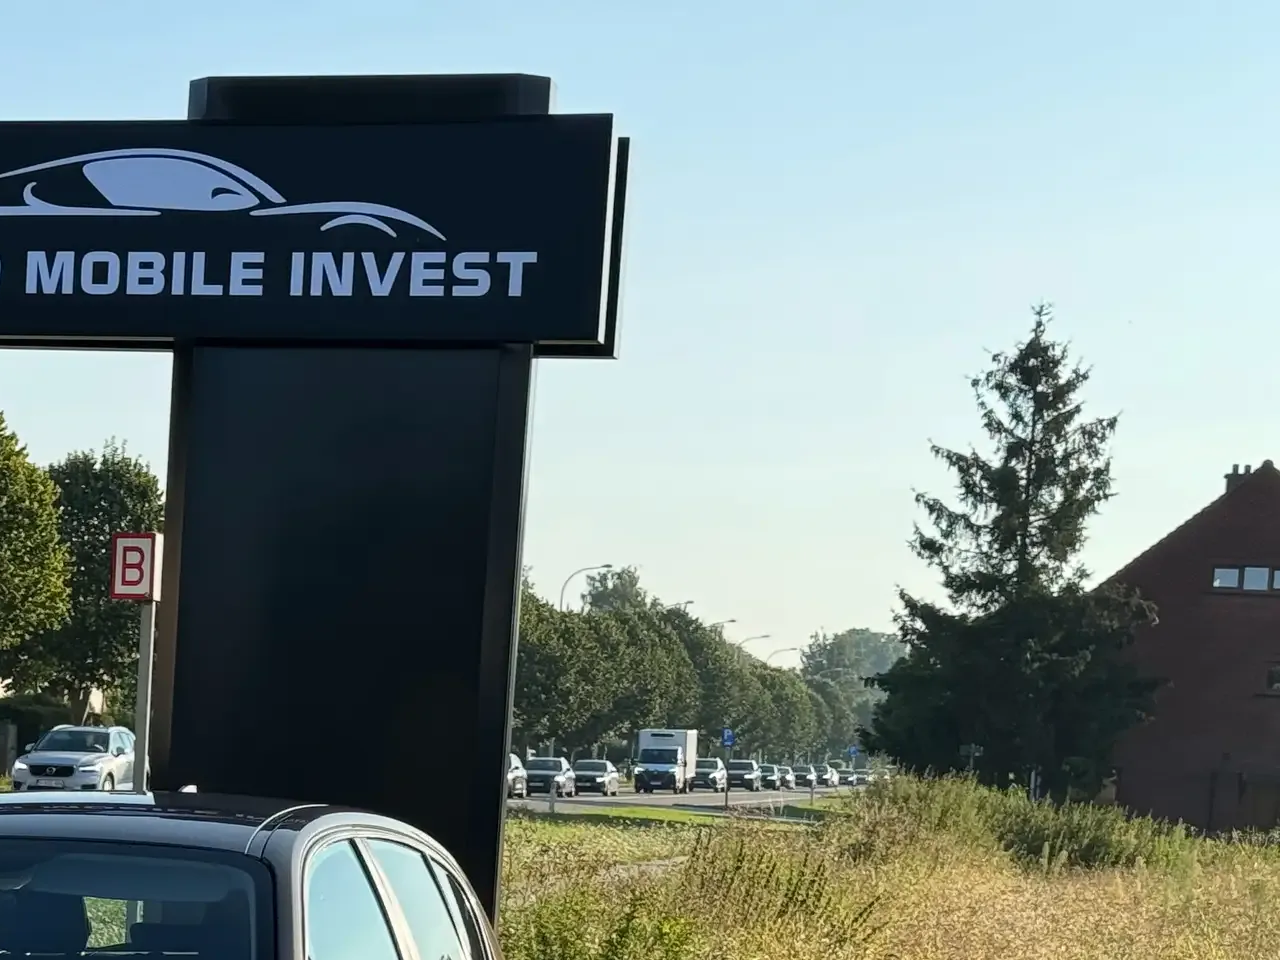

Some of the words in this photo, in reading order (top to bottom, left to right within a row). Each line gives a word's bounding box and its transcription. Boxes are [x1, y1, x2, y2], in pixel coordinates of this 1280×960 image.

[25, 250, 265, 295] MOBILE
[289, 251, 538, 296] INVEST
[121, 546, 145, 586] B
